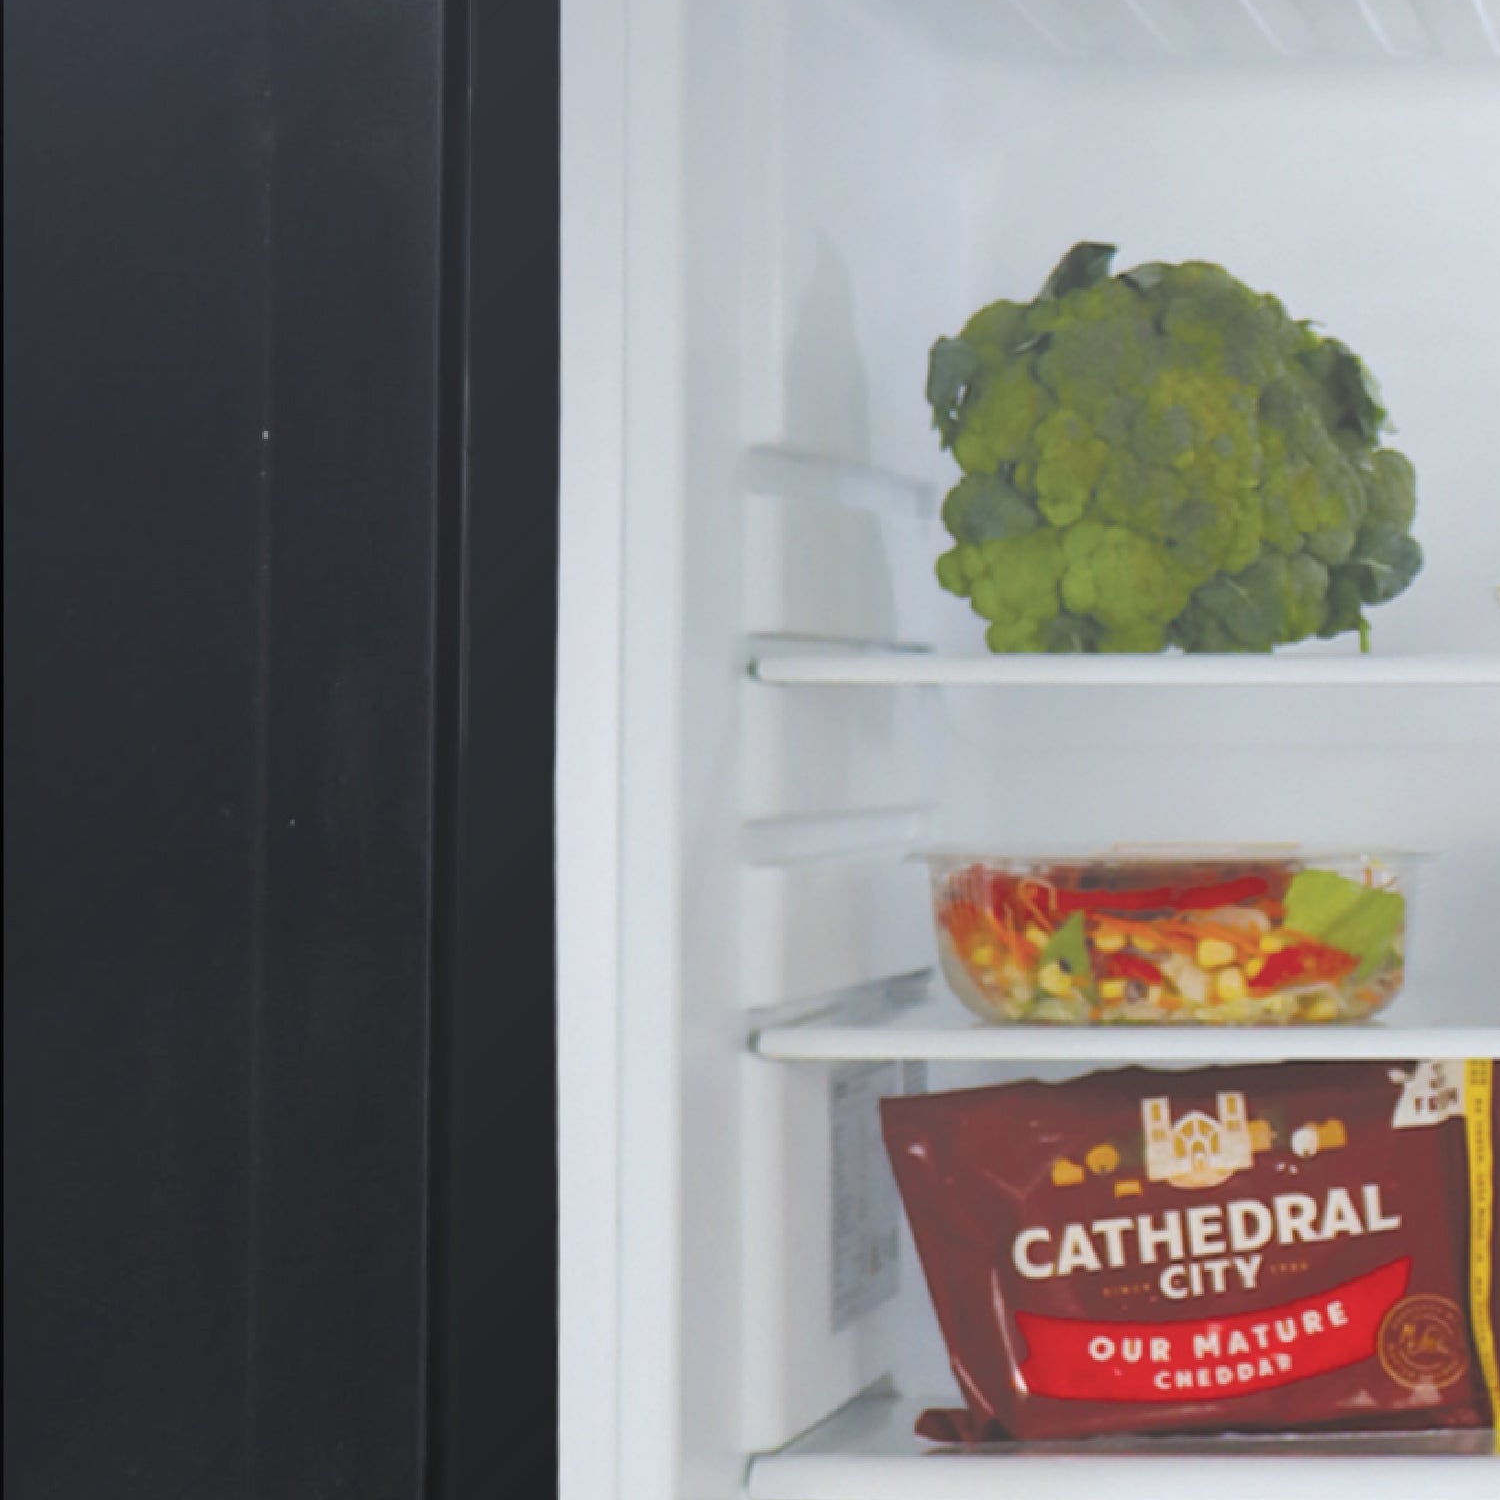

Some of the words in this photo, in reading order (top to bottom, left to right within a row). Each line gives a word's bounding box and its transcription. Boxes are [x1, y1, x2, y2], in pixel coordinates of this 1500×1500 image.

[1012, 1183, 1402, 1280] CATHEDRAL
[1159, 1254, 1263, 1300] CITY
[1088, 1336, 1172, 1364] OUR
[1192, 1299, 1350, 1361] MATURE
[1153, 1353, 1293, 1391] CHEDDAR
